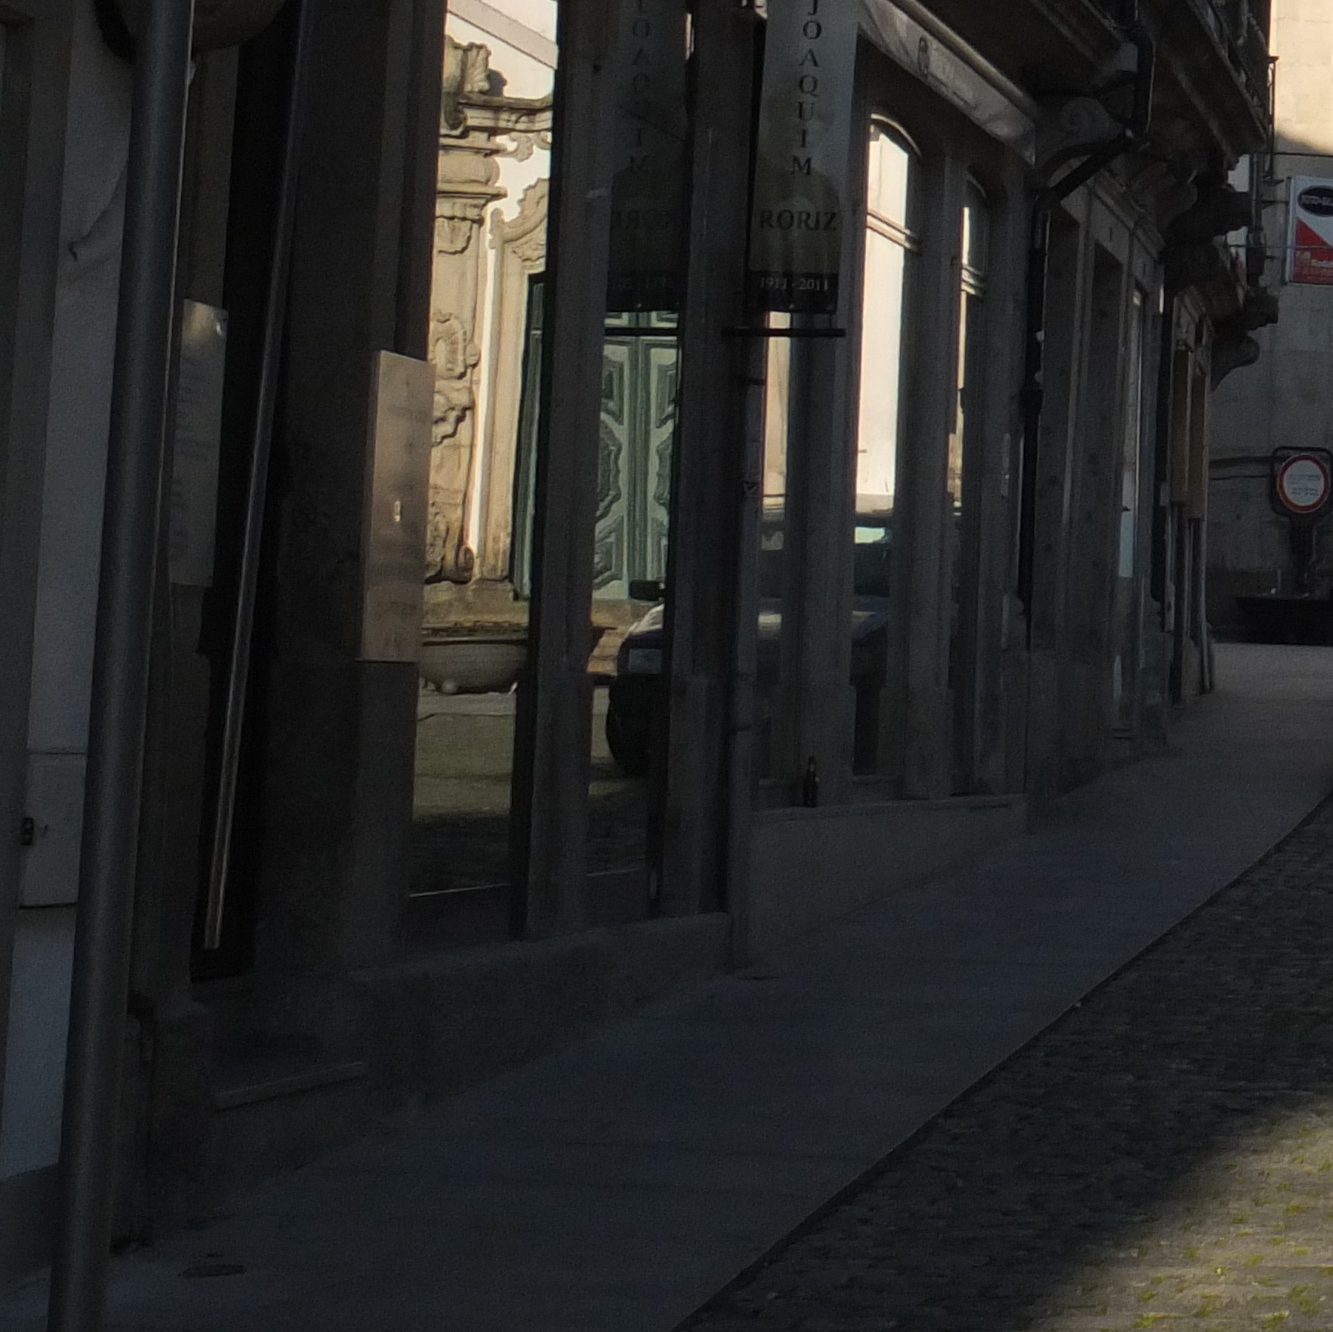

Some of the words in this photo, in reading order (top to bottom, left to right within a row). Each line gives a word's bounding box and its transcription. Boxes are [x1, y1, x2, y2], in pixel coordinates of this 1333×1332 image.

[759, 209, 837, 231] RORIZ
[759, 276, 789, 291] 1911
[799, 276, 829, 291] 2011
